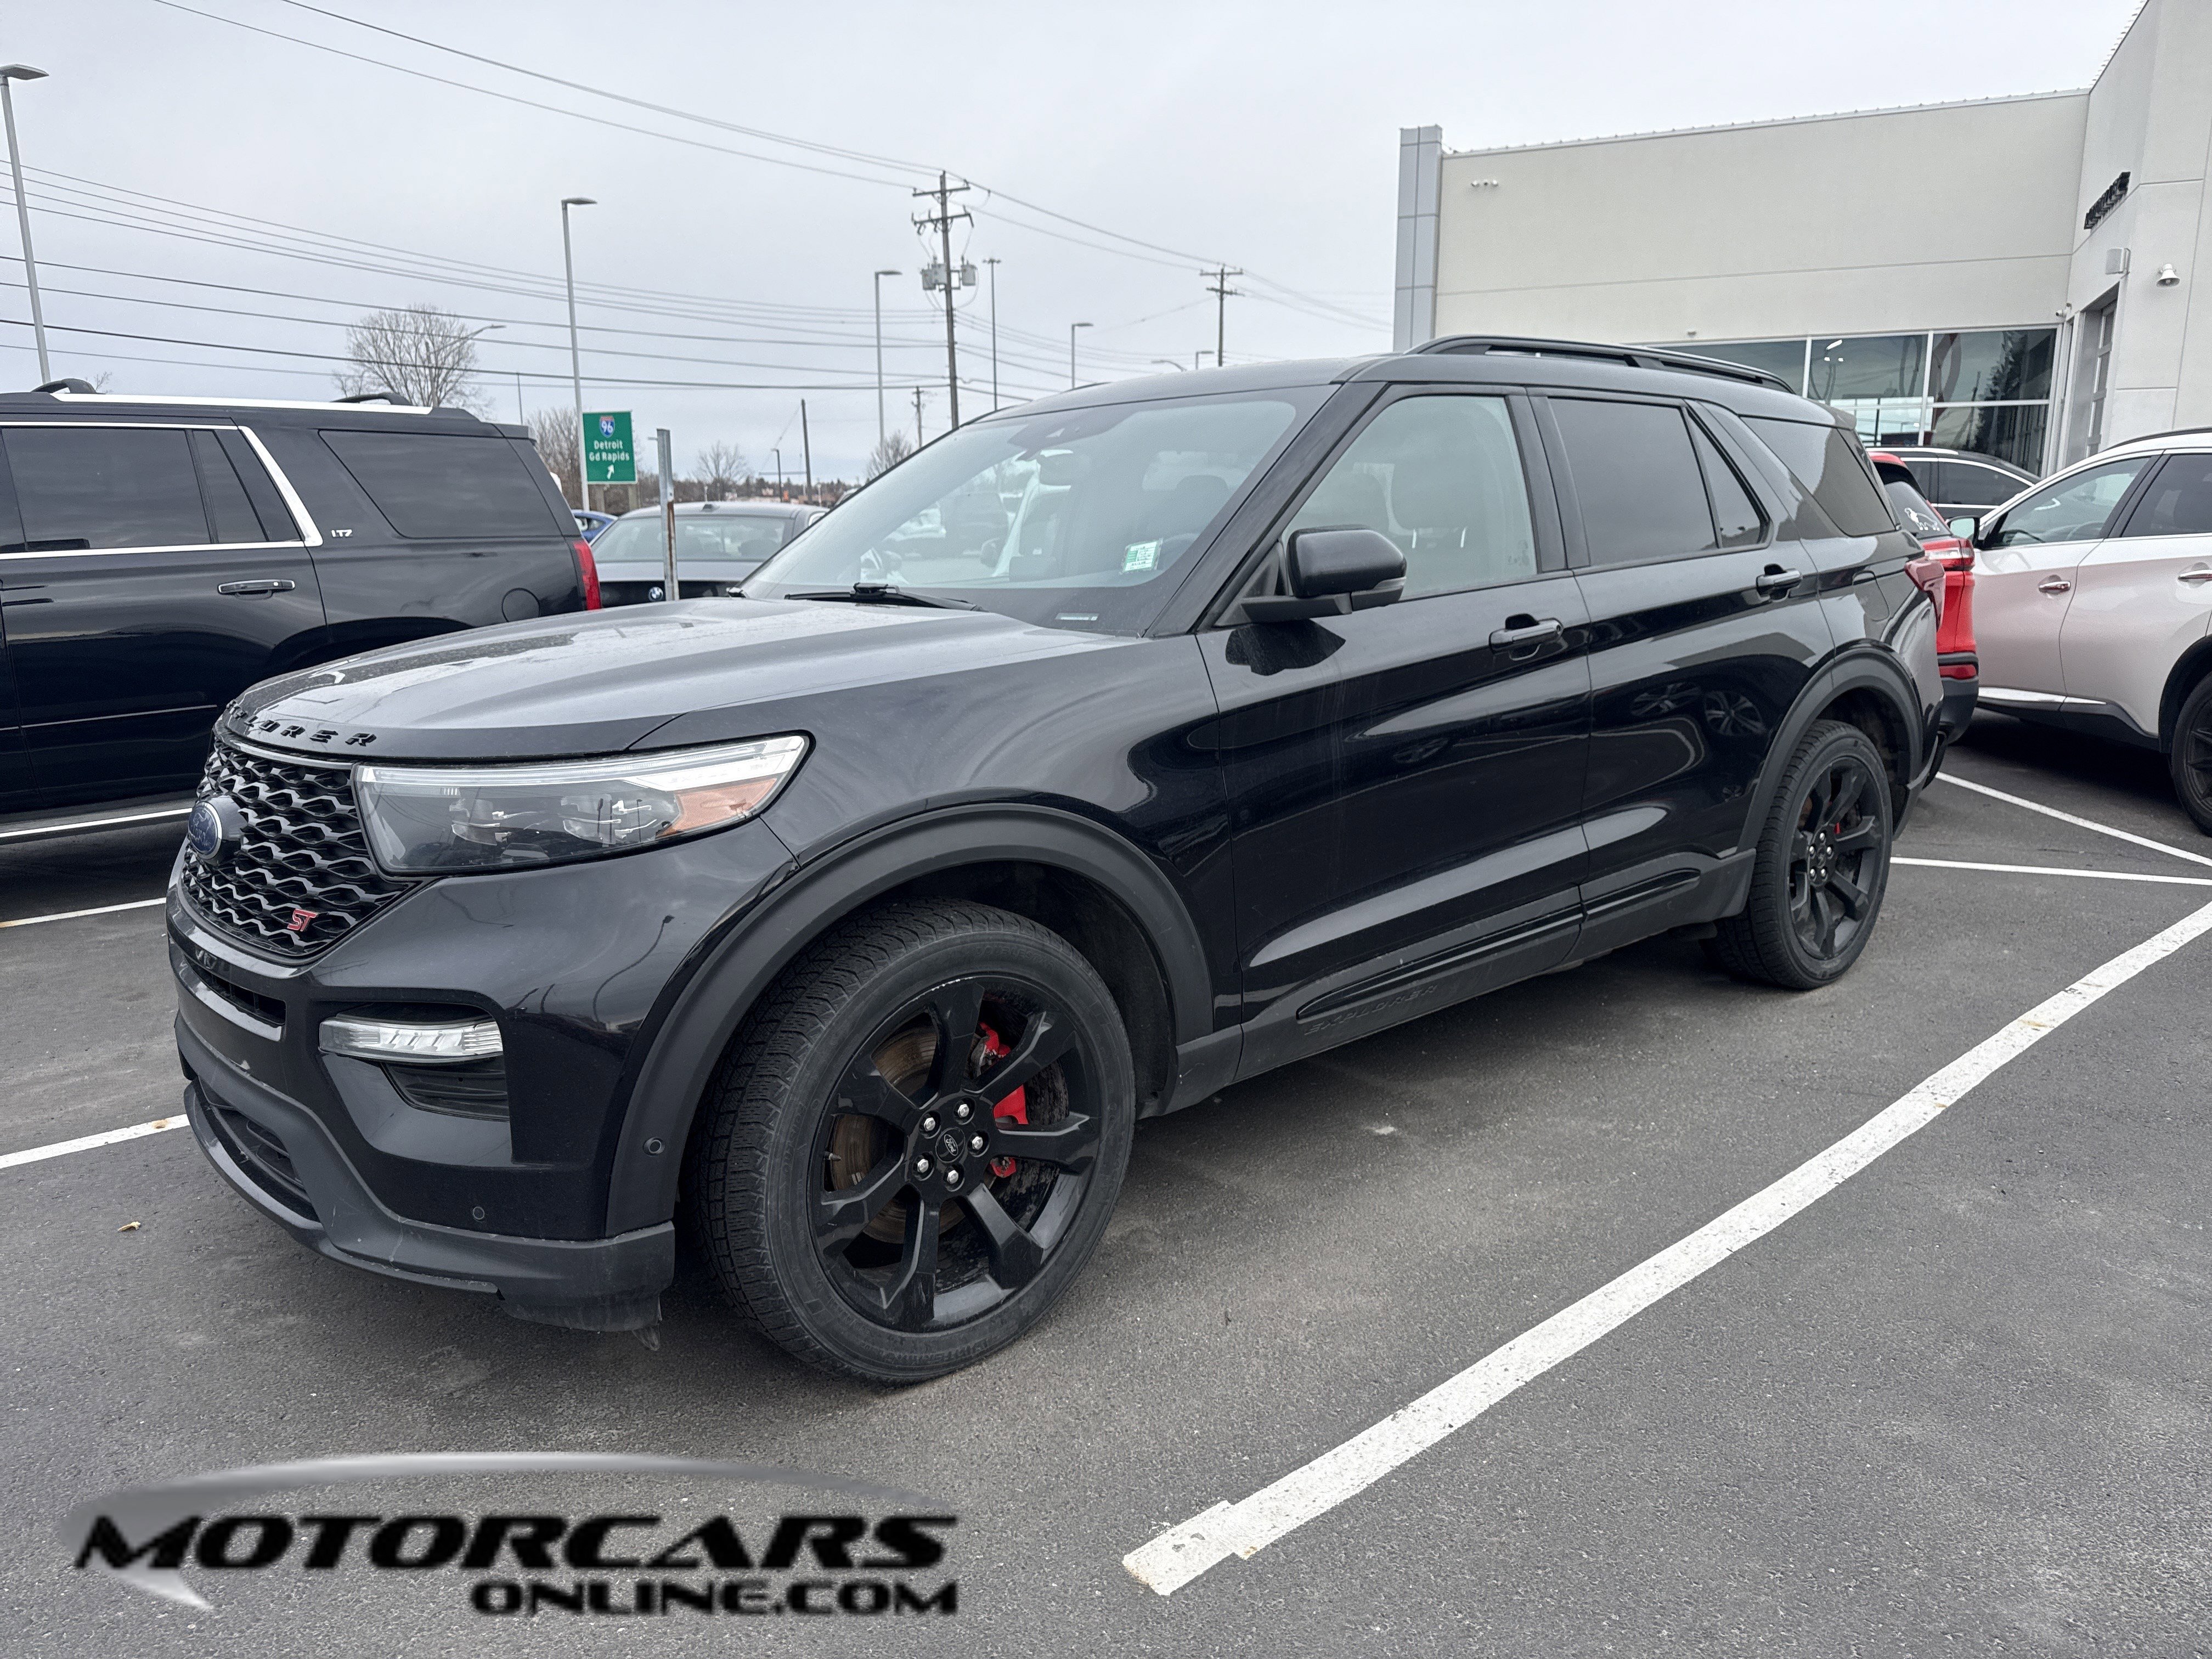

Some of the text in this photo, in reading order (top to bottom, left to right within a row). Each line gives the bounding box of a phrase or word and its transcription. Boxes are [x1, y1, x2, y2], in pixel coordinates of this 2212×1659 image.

[601, 420, 614, 433] 96
[594, 439, 623, 450] Detroit
[589, 452, 630, 463] Gd Rapids
[286, 908, 318, 932] ST
